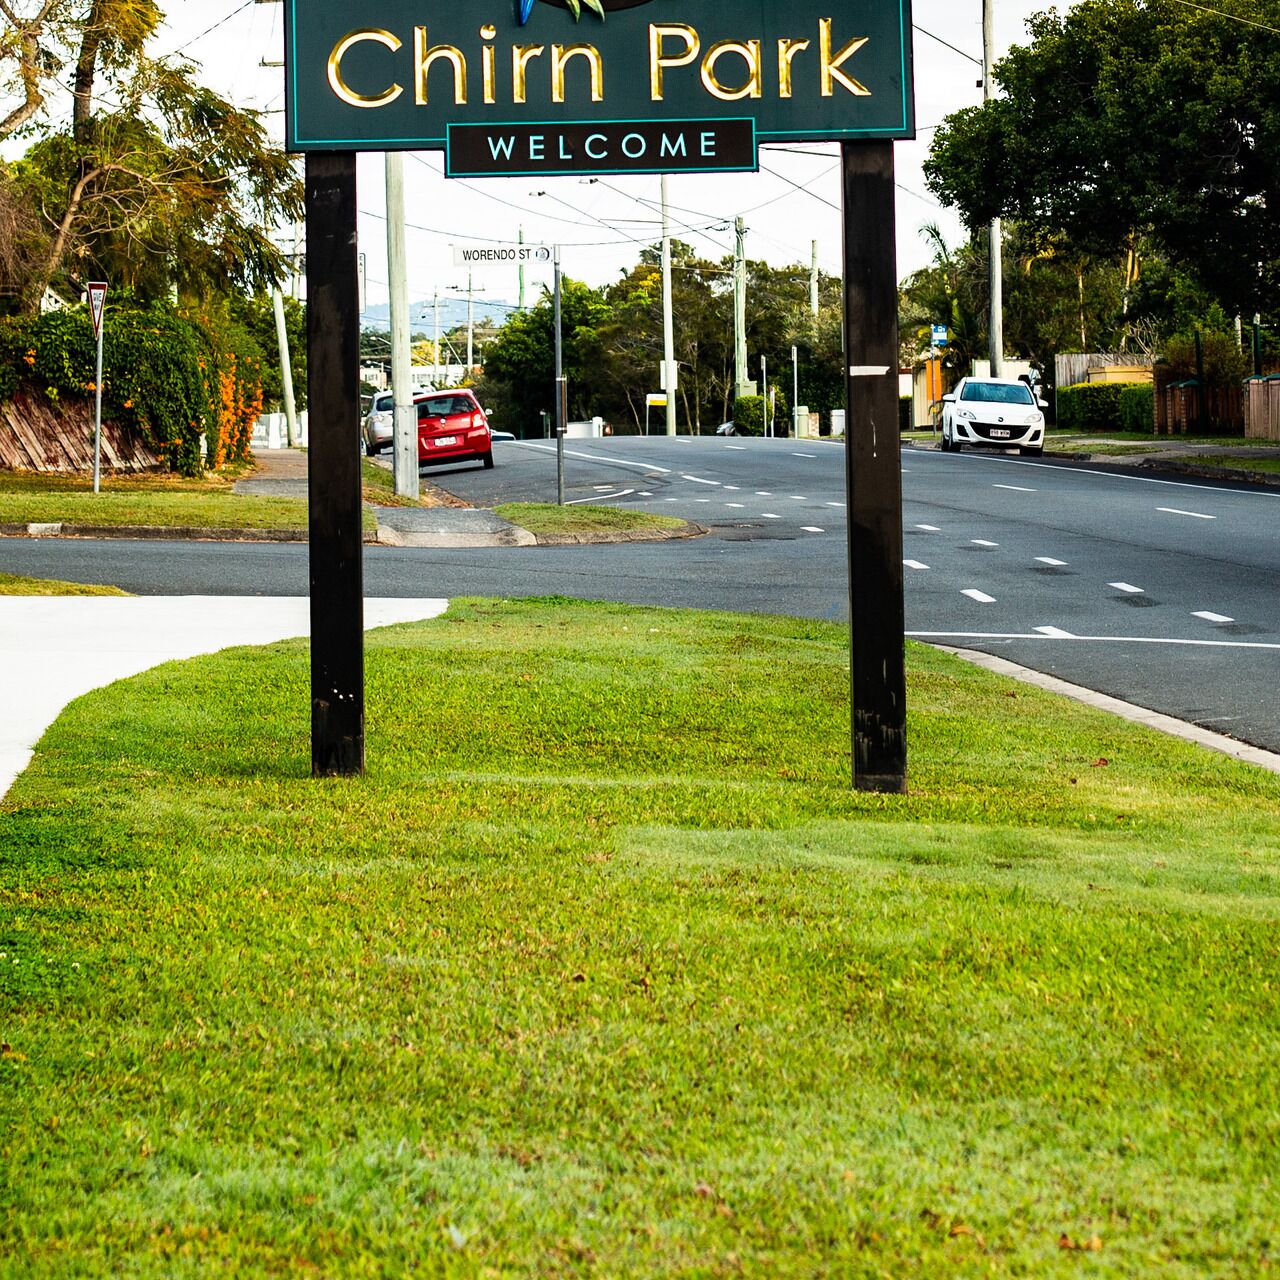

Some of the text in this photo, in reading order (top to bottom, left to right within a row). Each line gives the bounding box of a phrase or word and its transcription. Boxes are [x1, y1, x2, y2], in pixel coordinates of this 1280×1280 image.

[326, 17, 872, 108] Chirn Park
[487, 131, 717, 161] WELCOME
[462, 249, 531, 261] WORENDO ST
